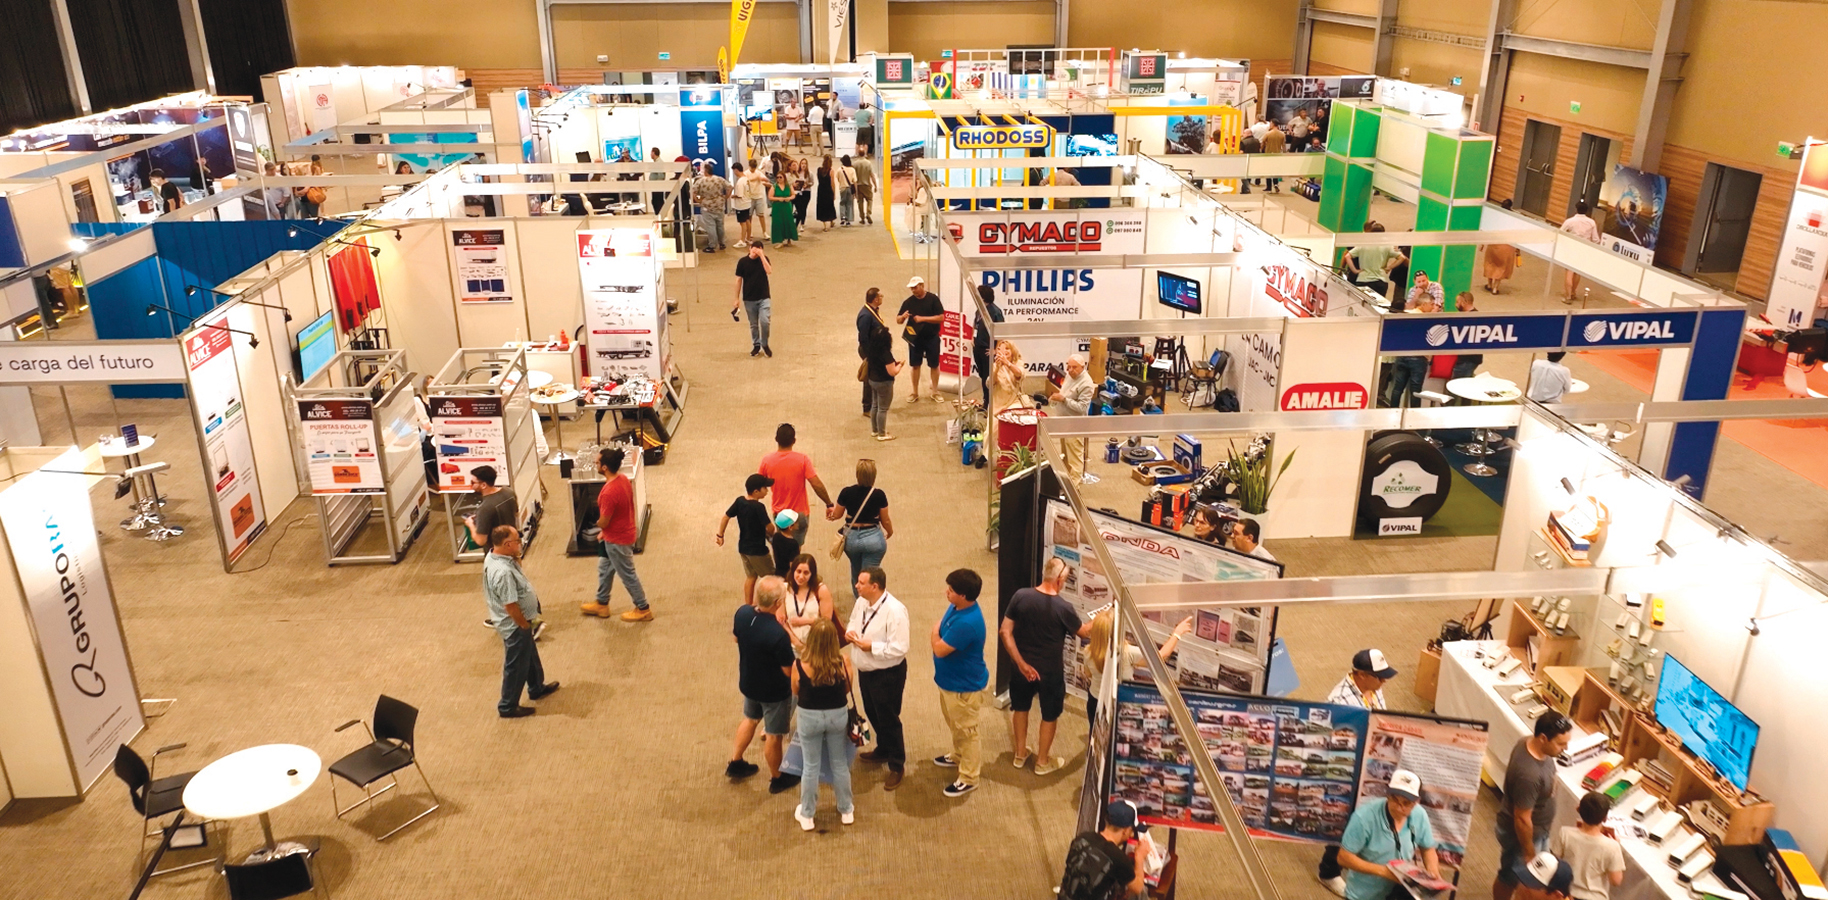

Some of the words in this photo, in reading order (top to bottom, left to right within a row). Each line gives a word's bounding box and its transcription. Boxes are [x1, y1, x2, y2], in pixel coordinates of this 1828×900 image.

[1130, 85, 1164, 94] TIRAPU
[697, 119, 709, 154] BILPA
[958, 129, 1045, 146] RHODOSS
[978, 220, 1102, 244] CYMACO
[982, 268, 1095, 292] PHILIPS
[1007, 296, 1065, 306] ILUMINACIÓN
[1016, 307, 1079, 316] PERFORMANCE
[1450, 324, 1518, 344] VIPAL
[1609, 320, 1675, 340] VIPAL
[9, 358, 61, 373] carga
[67, 354, 94, 369] del
[99, 354, 154, 369] futuro
[1024, 362, 1052, 372] PARA
[1286, 391, 1363, 410] AMALIE
[307, 410, 333, 418] ALVICE
[437, 406, 463, 415] ALVICE
[1383, 485, 1422, 494] RECOMER
[1391, 524, 1418, 532] VIPAL
